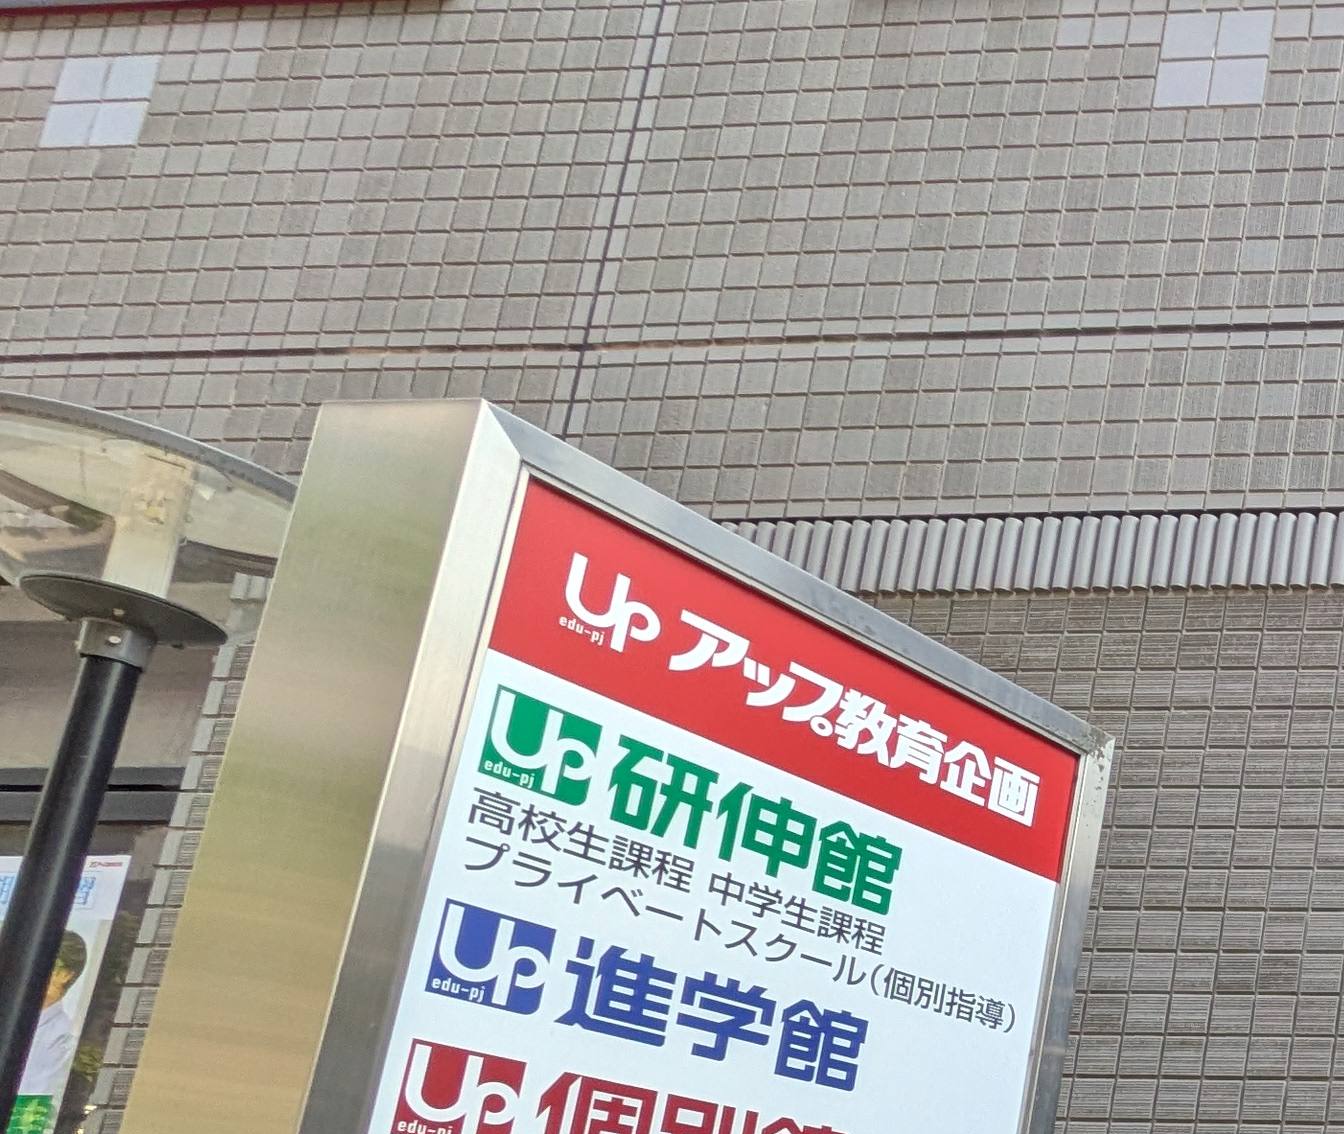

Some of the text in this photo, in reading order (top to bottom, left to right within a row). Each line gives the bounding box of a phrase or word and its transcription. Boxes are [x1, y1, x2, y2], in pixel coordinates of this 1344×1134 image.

[669, 608, 1041, 828] アップ教育企画
[468, 787, 887, 956] 高校生課程 中学生課程
[608, 734, 903, 916] 研伸館
[553, 936, 869, 1092] 進学館
